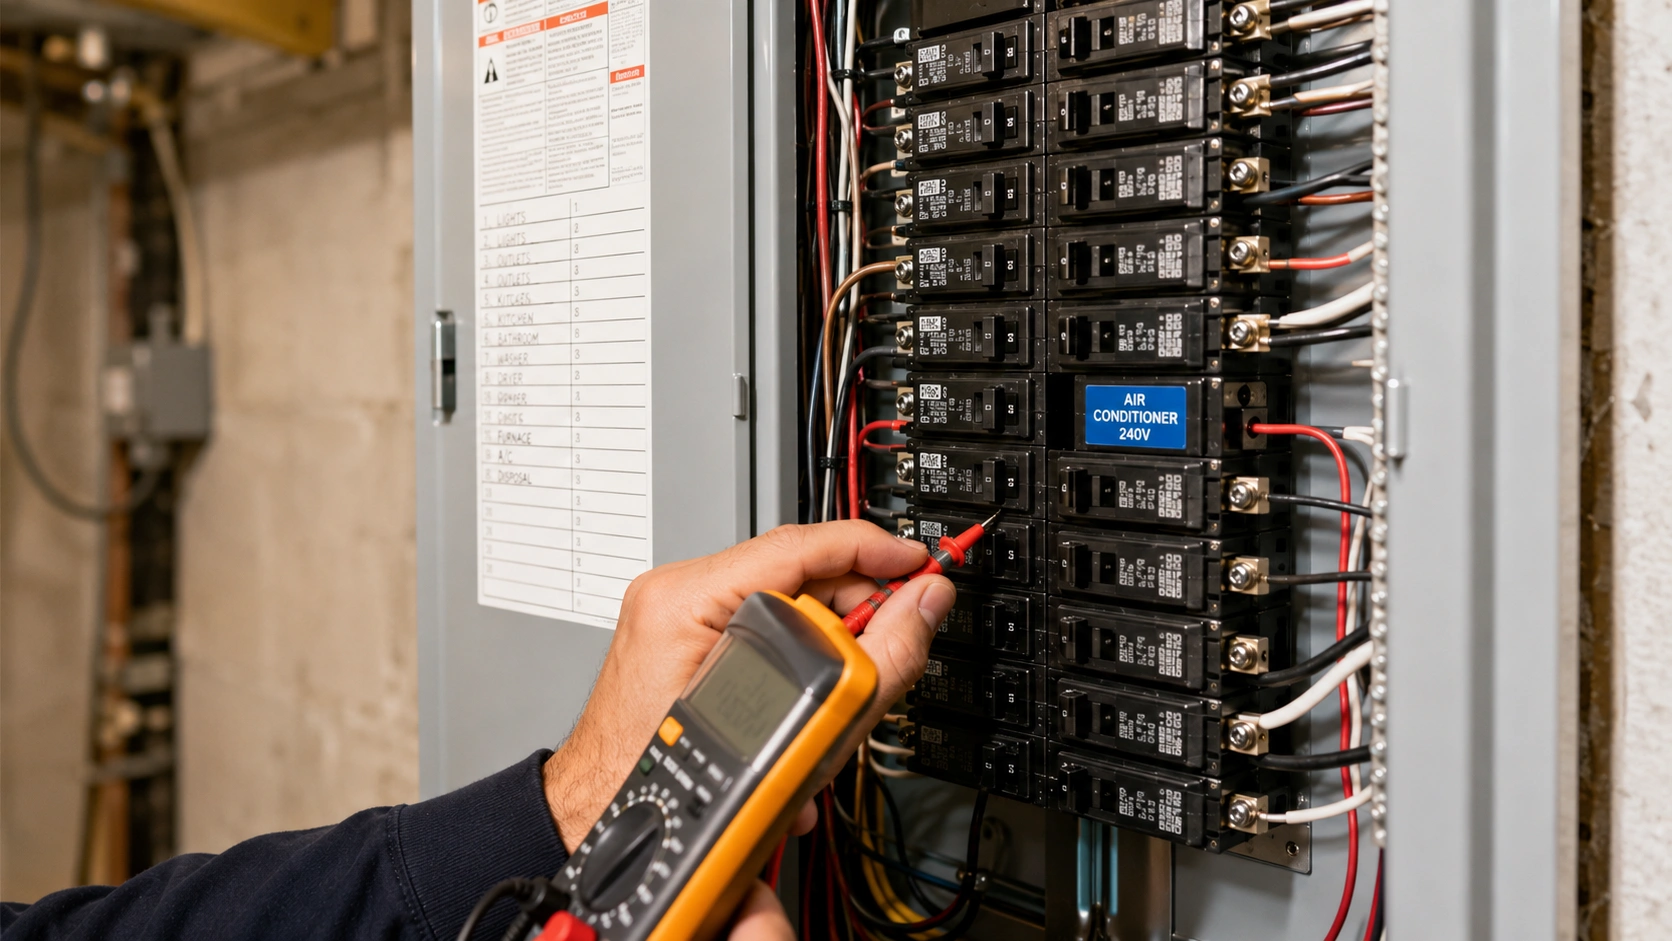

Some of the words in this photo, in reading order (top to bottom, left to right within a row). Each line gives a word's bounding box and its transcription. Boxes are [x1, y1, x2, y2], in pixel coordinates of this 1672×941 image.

[497, 211, 526, 227] LIGHTS
[497, 232, 526, 248] LIGHTS
[497, 252, 531, 268] OUTLETS
[497, 272, 531, 288] OUTLETS
[1124, 393, 1145, 406] AIR
[1093, 409, 1178, 424] CONDITIONER
[498, 430, 532, 446] FURNACE
[1119, 427, 1151, 441] 240V
[498, 449, 513, 464] A/C
[498, 469, 532, 485] DISPOSAL
